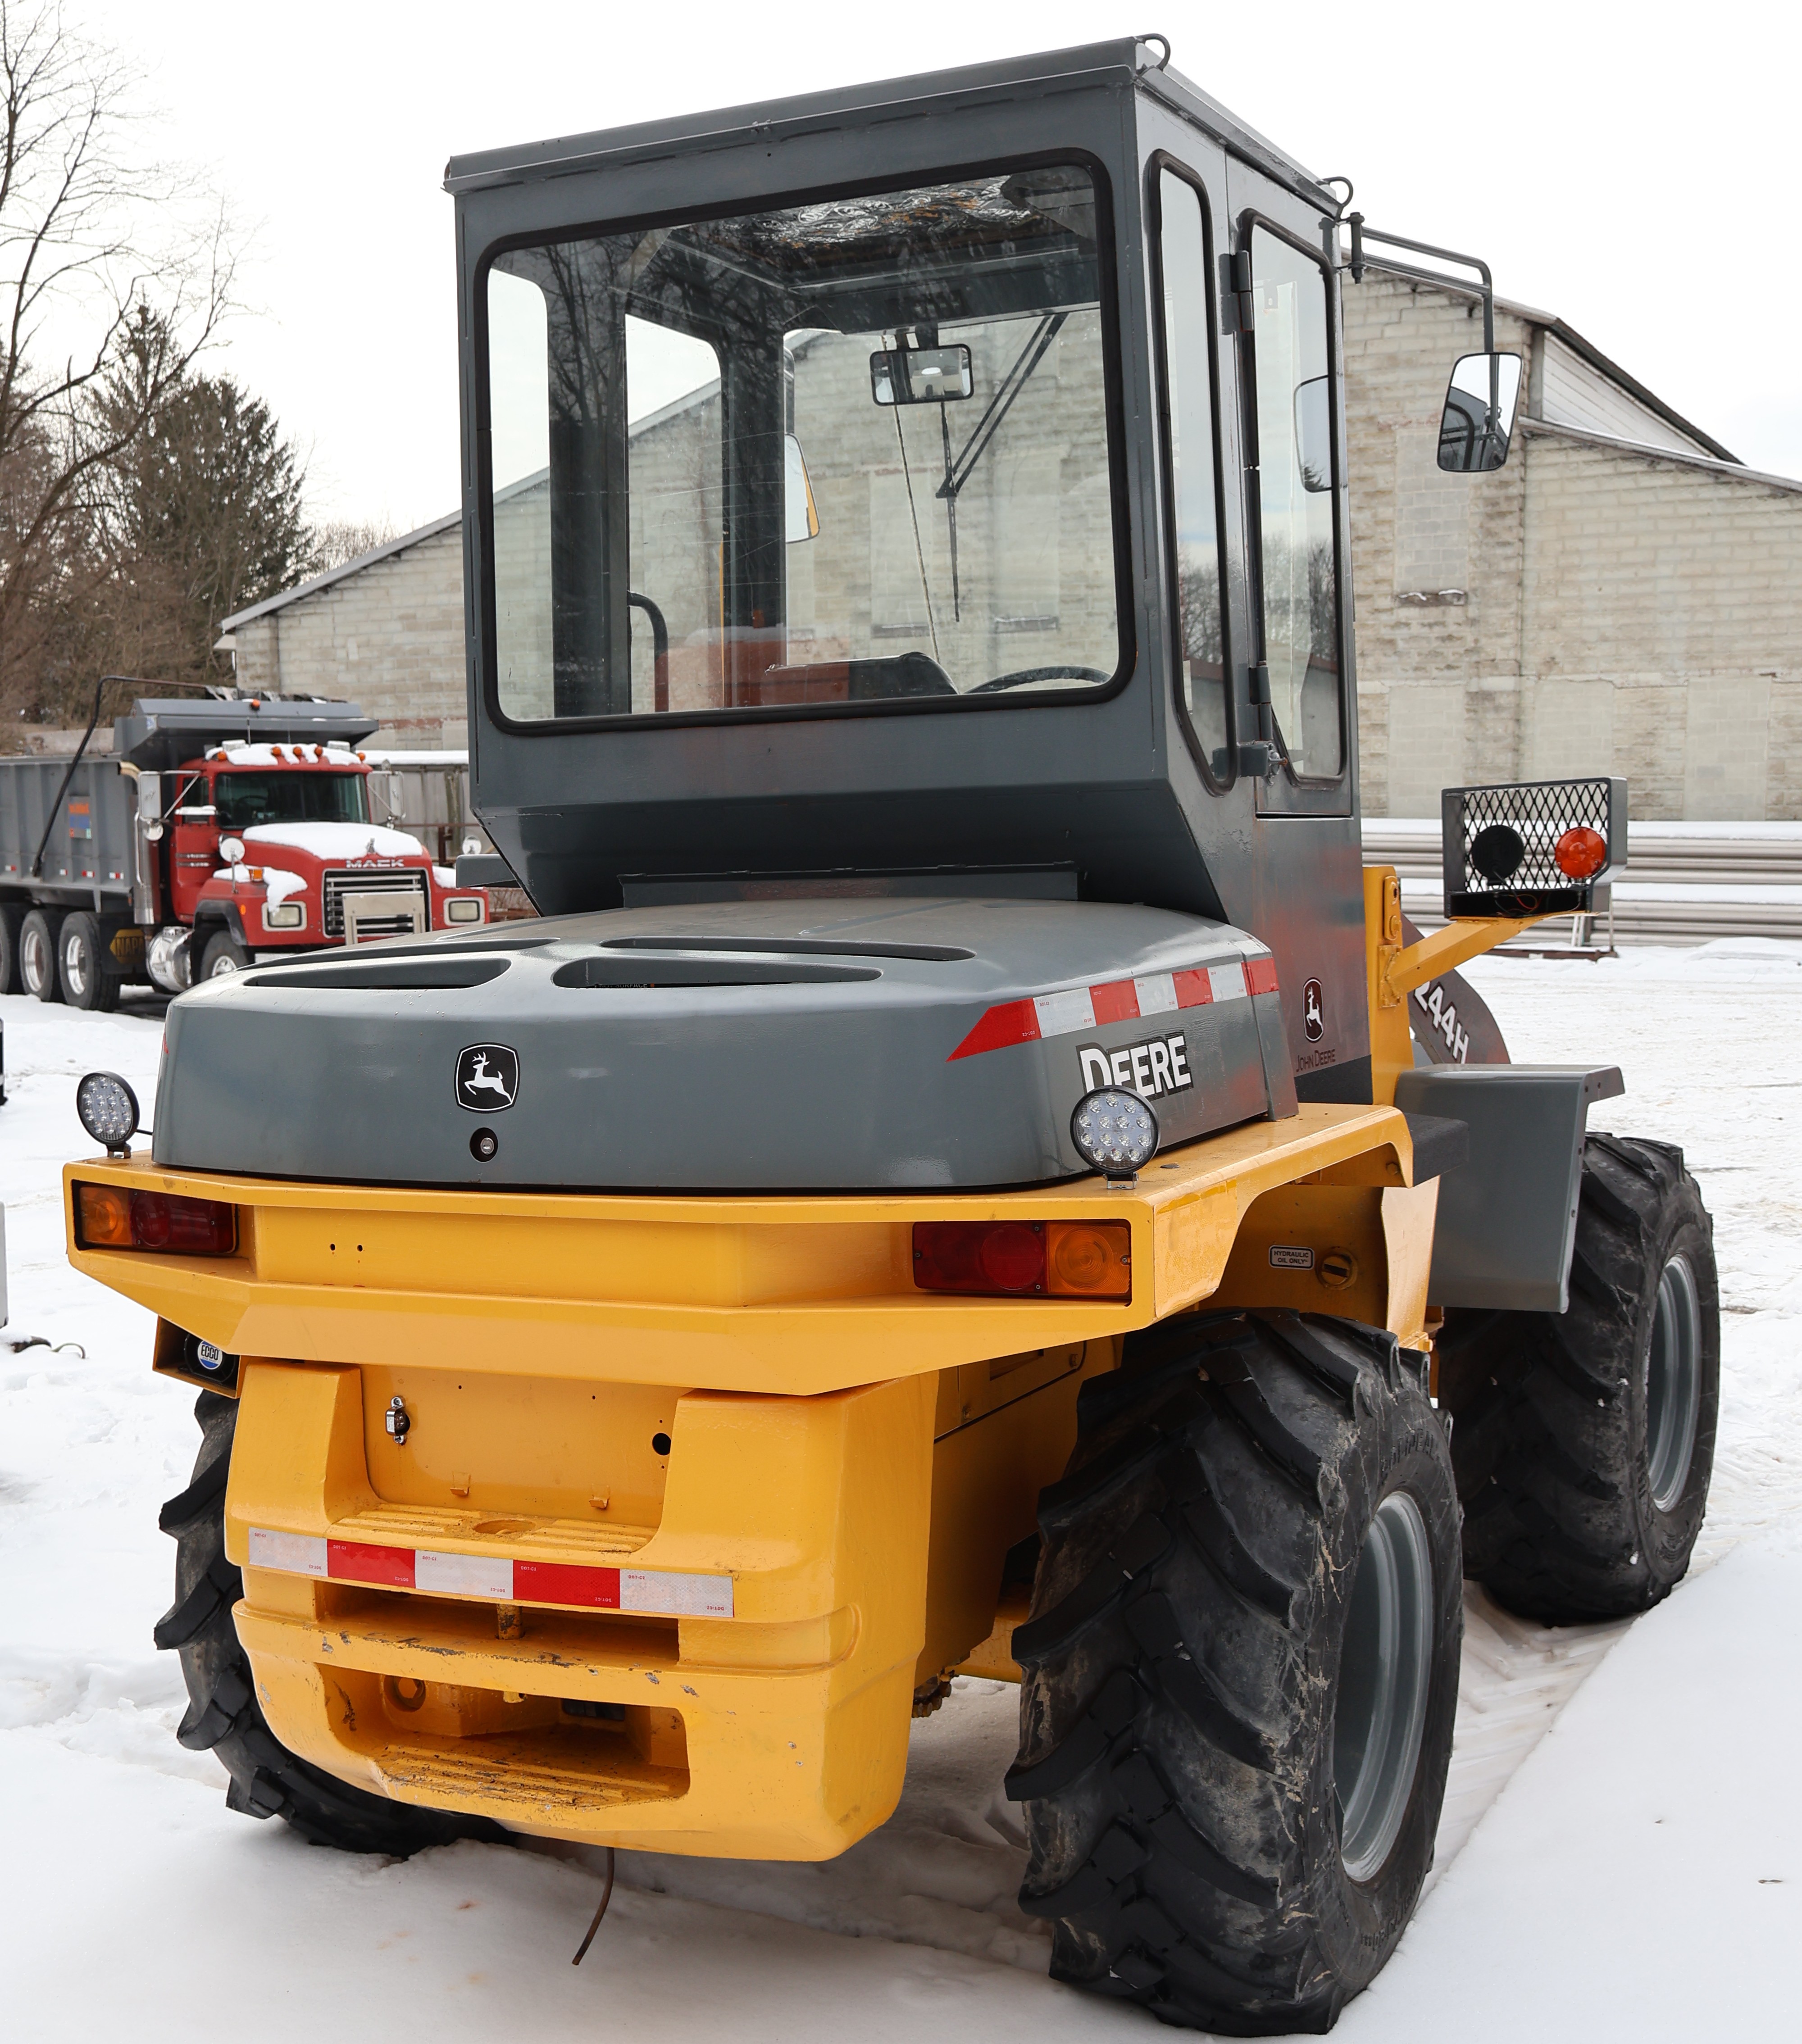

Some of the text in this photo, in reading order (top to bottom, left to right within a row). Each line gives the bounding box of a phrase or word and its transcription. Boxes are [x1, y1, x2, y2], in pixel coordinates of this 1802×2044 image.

[346, 859, 405, 868] MACK
[1414, 981, 1469, 1064] 244H
[1079, 1036, 1192, 1097] DEERE
[1296, 1049, 1335, 1072] JOHN DEERE
[201, 1345, 219, 1360] ECCO
